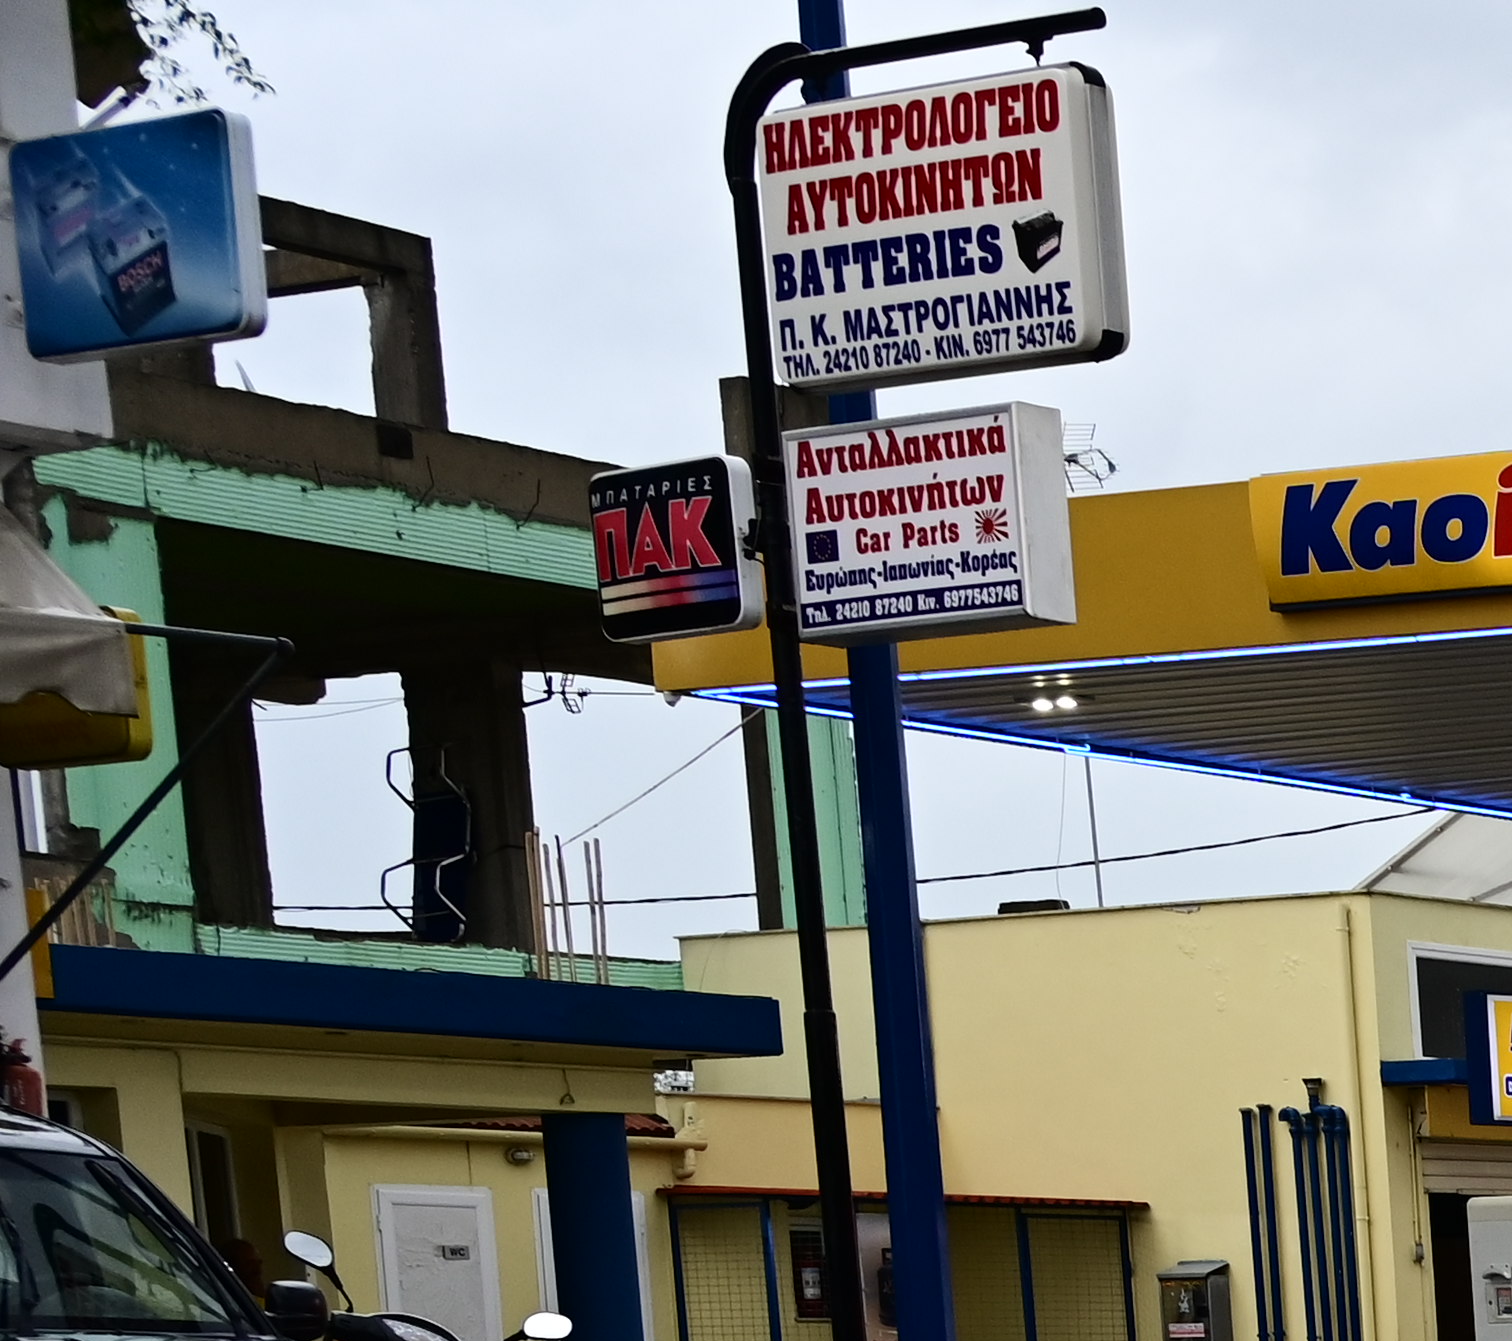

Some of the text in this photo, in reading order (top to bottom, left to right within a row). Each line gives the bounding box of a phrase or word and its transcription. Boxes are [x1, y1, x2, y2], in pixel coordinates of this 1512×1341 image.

[763, 79, 1060, 174] ΗΛΕΚΤΡΟΛΟΓΕΙΟ
[787, 148, 1043, 235] ΑΥΤΟΚΙΝΗΤΩΝ
[772, 224, 1003, 302] BATTERIES
[779, 281, 1073, 351] Π. Κ. ΜΑΣΤΡΟΓΙΑΝΝΗΣ
[783, 353, 820, 379] ΤΗΛ.
[825, 345, 869, 374] 24210
[874, 338, 921, 369] 87240
[934, 332, 970, 361] ΚΙΝ.
[973, 326, 1010, 352] 6977
[1017, 319, 1076, 350] 543746
[796, 415, 1006, 478] Ανταλλακτικά
[591, 475, 712, 508] ΜΠΑΤΑΡΙΕΣ
[805, 472, 1004, 525] Αυτοκινήτων
[593, 495, 722, 583] ΠΑΚ
[856, 520, 960, 554] Car Parts
[806, 584, 1020, 624] Τηλ. 24210 87240 Κιν. 6977543746
